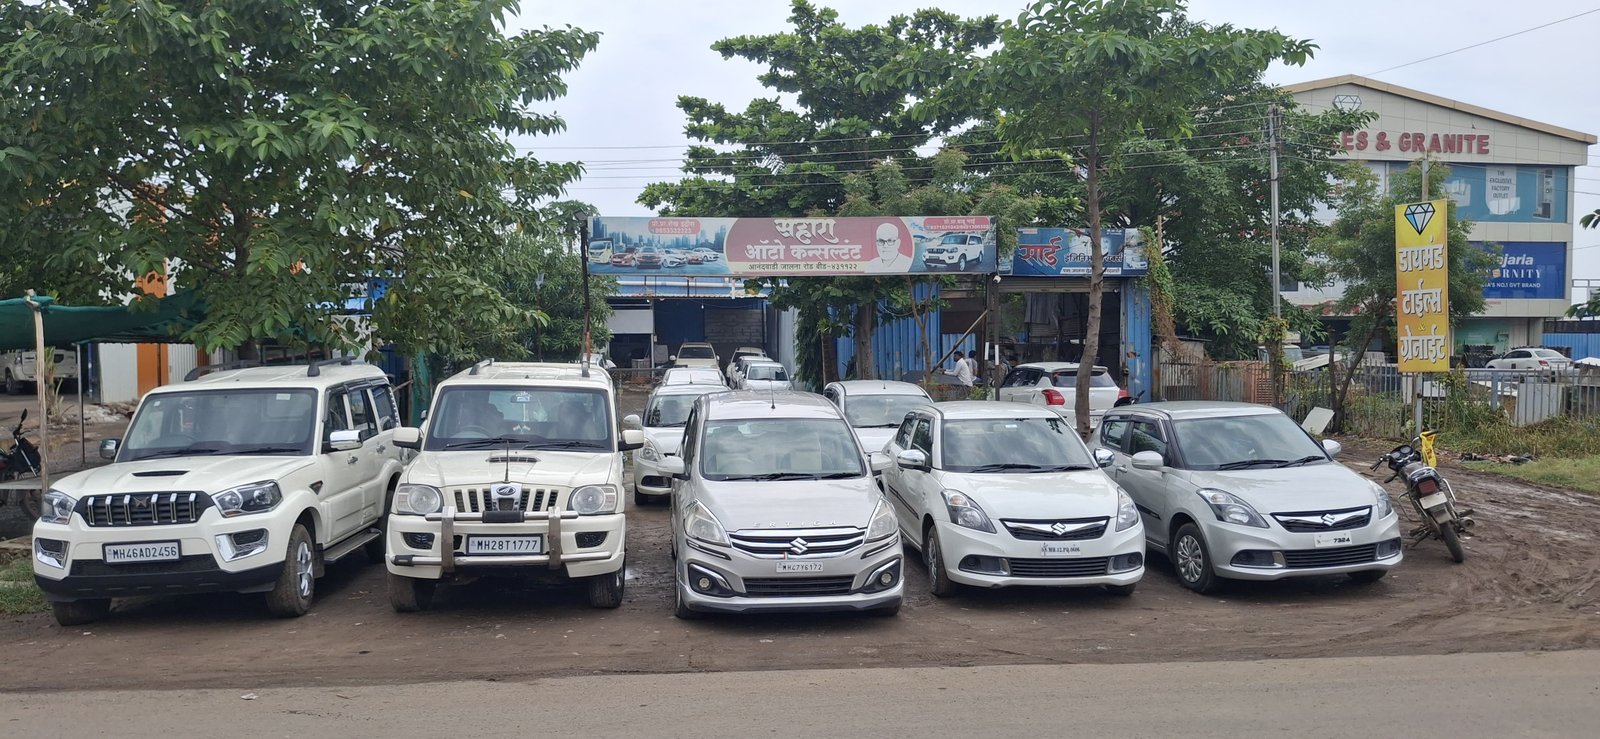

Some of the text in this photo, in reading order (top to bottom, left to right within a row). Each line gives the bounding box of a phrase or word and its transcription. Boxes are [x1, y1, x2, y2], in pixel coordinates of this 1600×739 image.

[1375, 132, 1392, 151] &
[1398, 132, 1490, 155] GRANITE
[774, 219, 839, 245] सहारा
[745, 239, 785, 259] ऑटो
[1399, 234, 1444, 272] डायमंड
[803, 262, 814, 270] रोड
[1402, 278, 1443, 317] टाईल्स
[1400, 324, 1446, 363] ग्रेनाईट
[112, 546, 177, 560] MH46AD2456
[477, 540, 538, 550] MH28T1777
